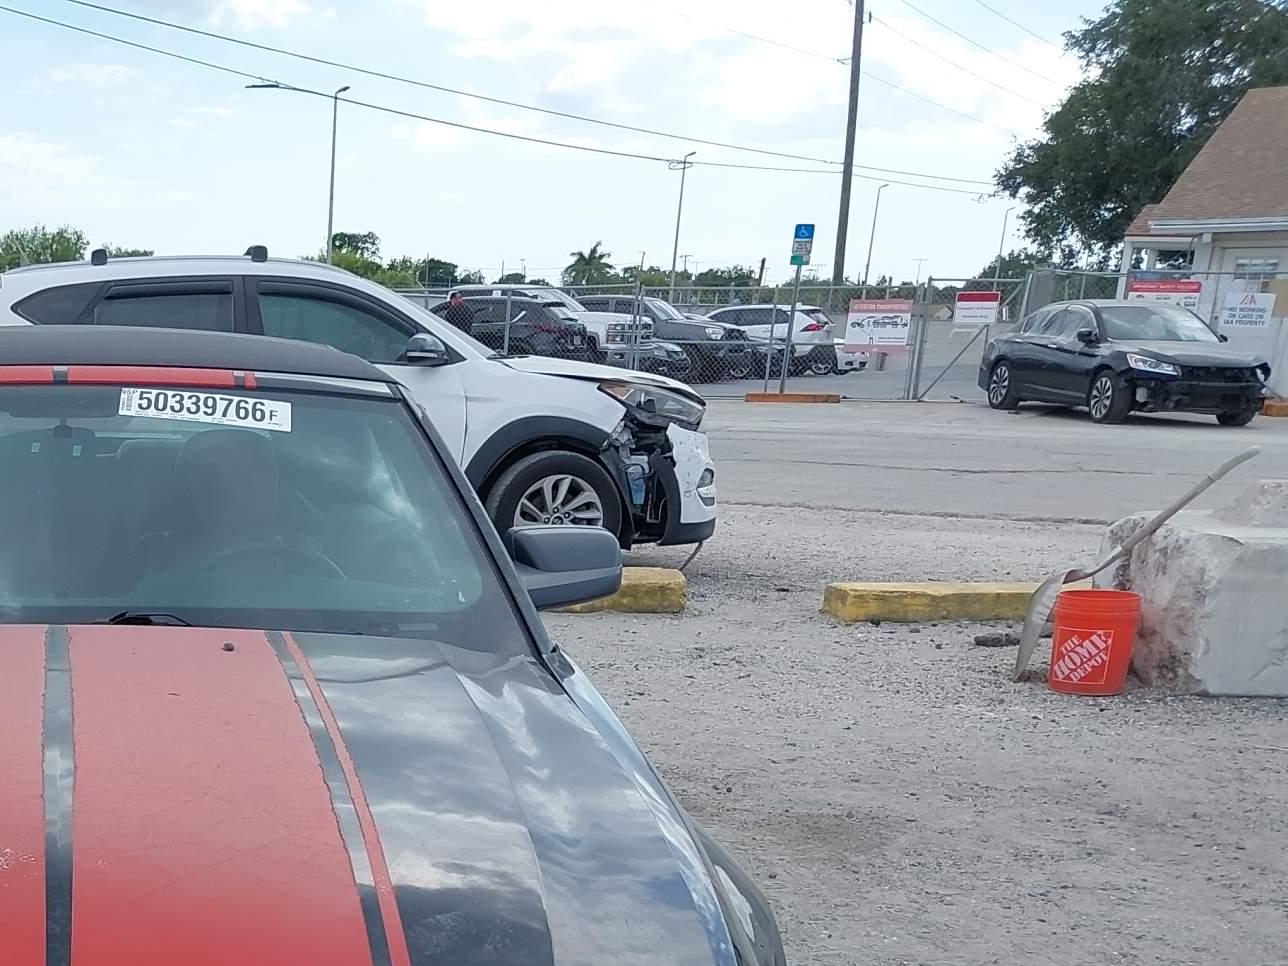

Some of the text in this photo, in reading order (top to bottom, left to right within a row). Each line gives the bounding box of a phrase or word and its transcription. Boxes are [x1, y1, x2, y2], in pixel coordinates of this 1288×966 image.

[1054, 631, 1111, 680] HOME
[1060, 634, 1082, 655] THE
[1069, 650, 1108, 682] DEPOT
